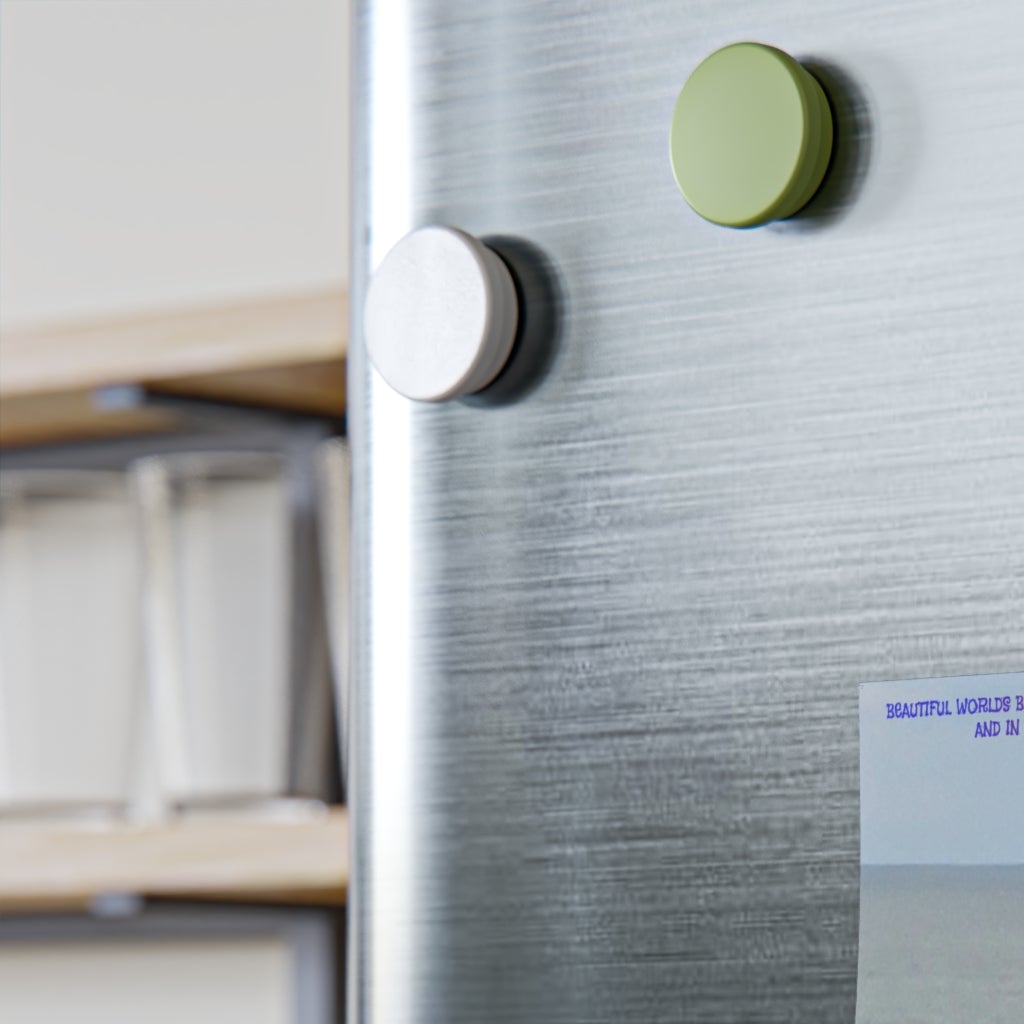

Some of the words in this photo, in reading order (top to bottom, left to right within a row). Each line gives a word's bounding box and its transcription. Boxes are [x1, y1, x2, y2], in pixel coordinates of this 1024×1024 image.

[886, 700, 952, 719] BEAUTIFUL
[956, 696, 1011, 715] WORLDS
[974, 720, 1000, 738] AND
[1005, 718, 1020, 736] IN
